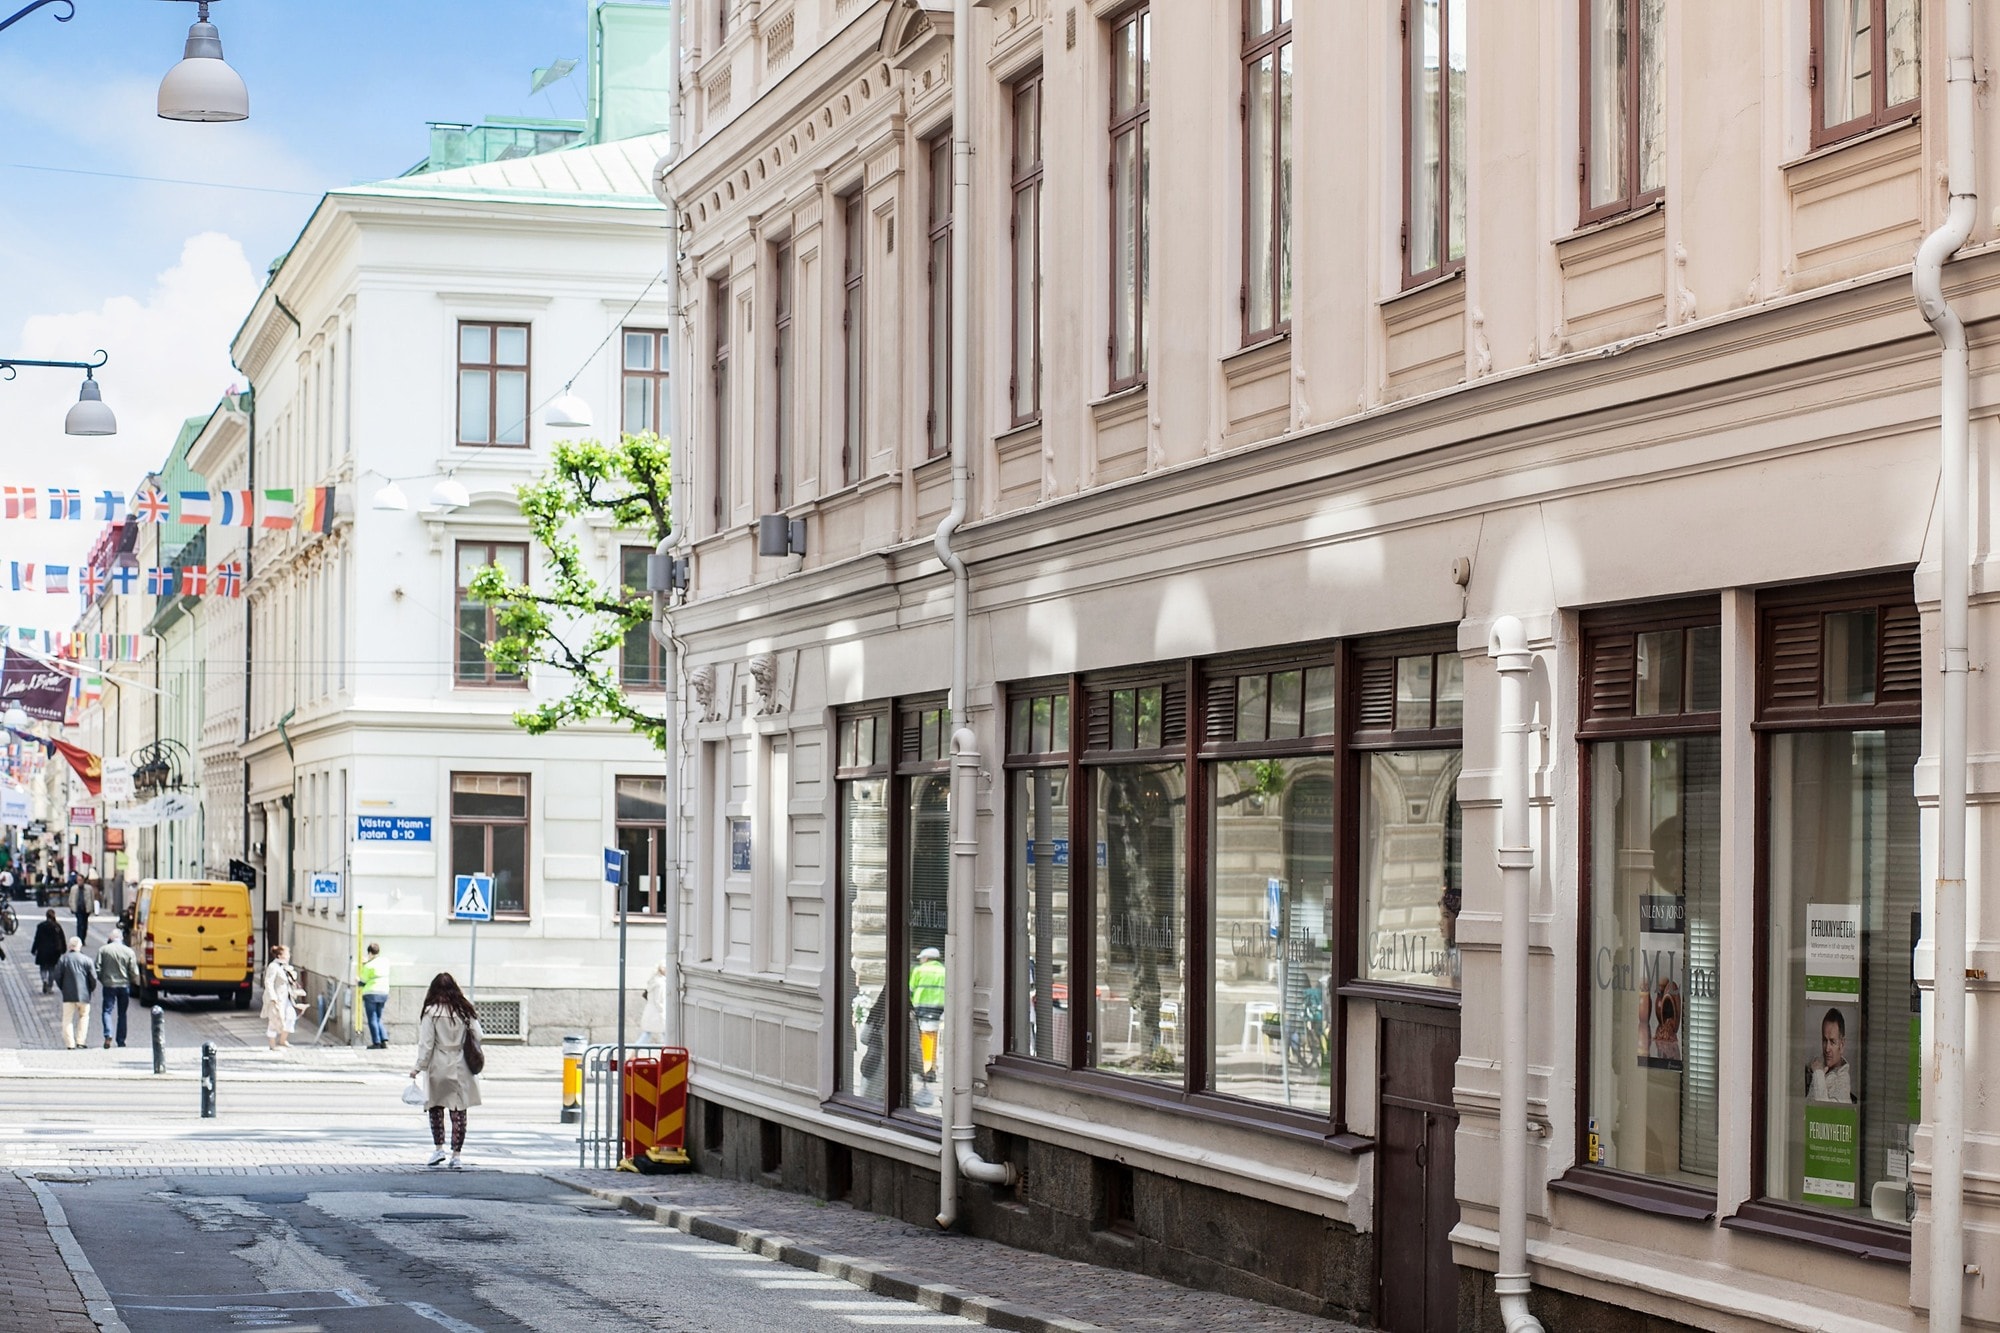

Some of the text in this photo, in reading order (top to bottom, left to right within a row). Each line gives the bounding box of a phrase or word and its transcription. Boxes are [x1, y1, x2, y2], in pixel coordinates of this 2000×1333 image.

[360, 818, 392, 829] Västra
[360, 829, 415, 841] gatan 8-10
[175, 905, 228, 918] DHL
[1666, 905, 1684, 922] JORD
[1139, 915, 1173, 949] Lundh
[1811, 919, 1856, 938] PERUKNYHETER!
[1231, 921, 1256, 958] Carl
[1368, 931, 1397, 971] Carl
[1400, 934, 1417, 973] M
[1596, 946, 1636, 992] Carl
[1641, 949, 1661, 994] M
[1809, 1121, 1852, 1143] PERUKNYHETER!
